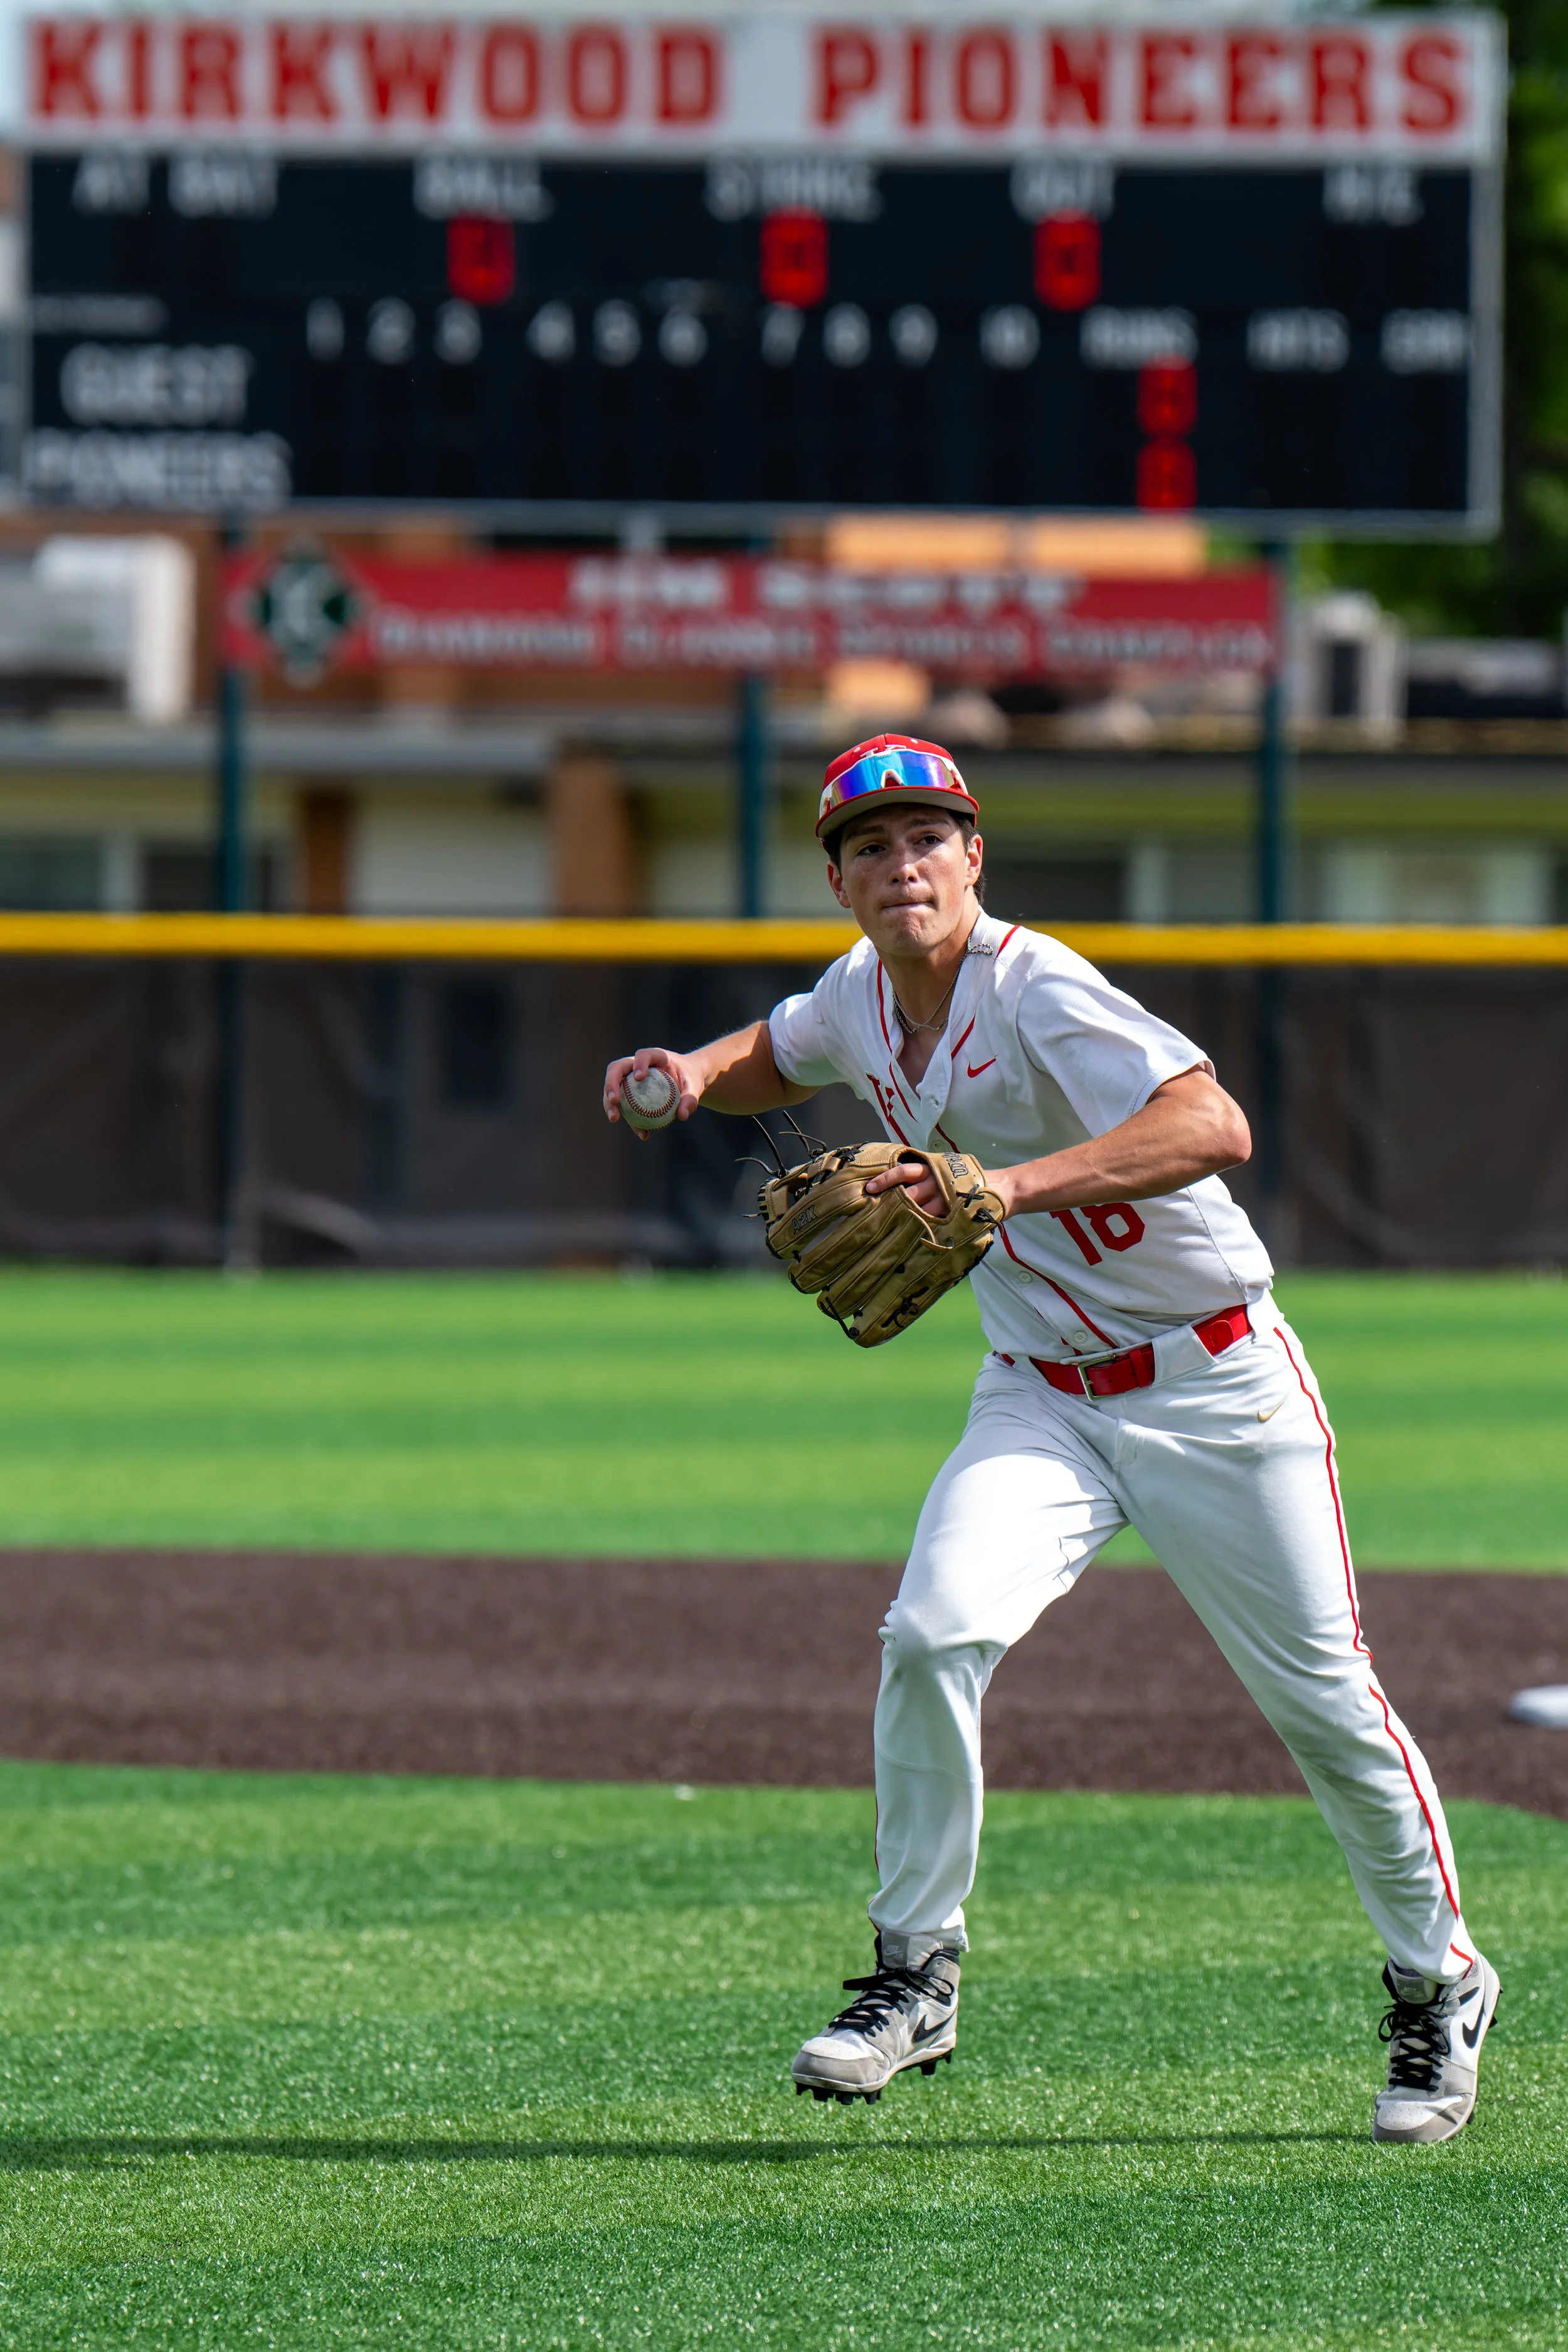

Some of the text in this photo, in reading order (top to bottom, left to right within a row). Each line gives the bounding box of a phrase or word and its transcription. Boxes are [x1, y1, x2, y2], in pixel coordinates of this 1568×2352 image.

[33, 22, 1465, 135] KIRKWOOD PIONEERS
[414, 156, 551, 222] BALL
[63, 345, 250, 425] GUEST
[792, 1204, 817, 1236] A2K
